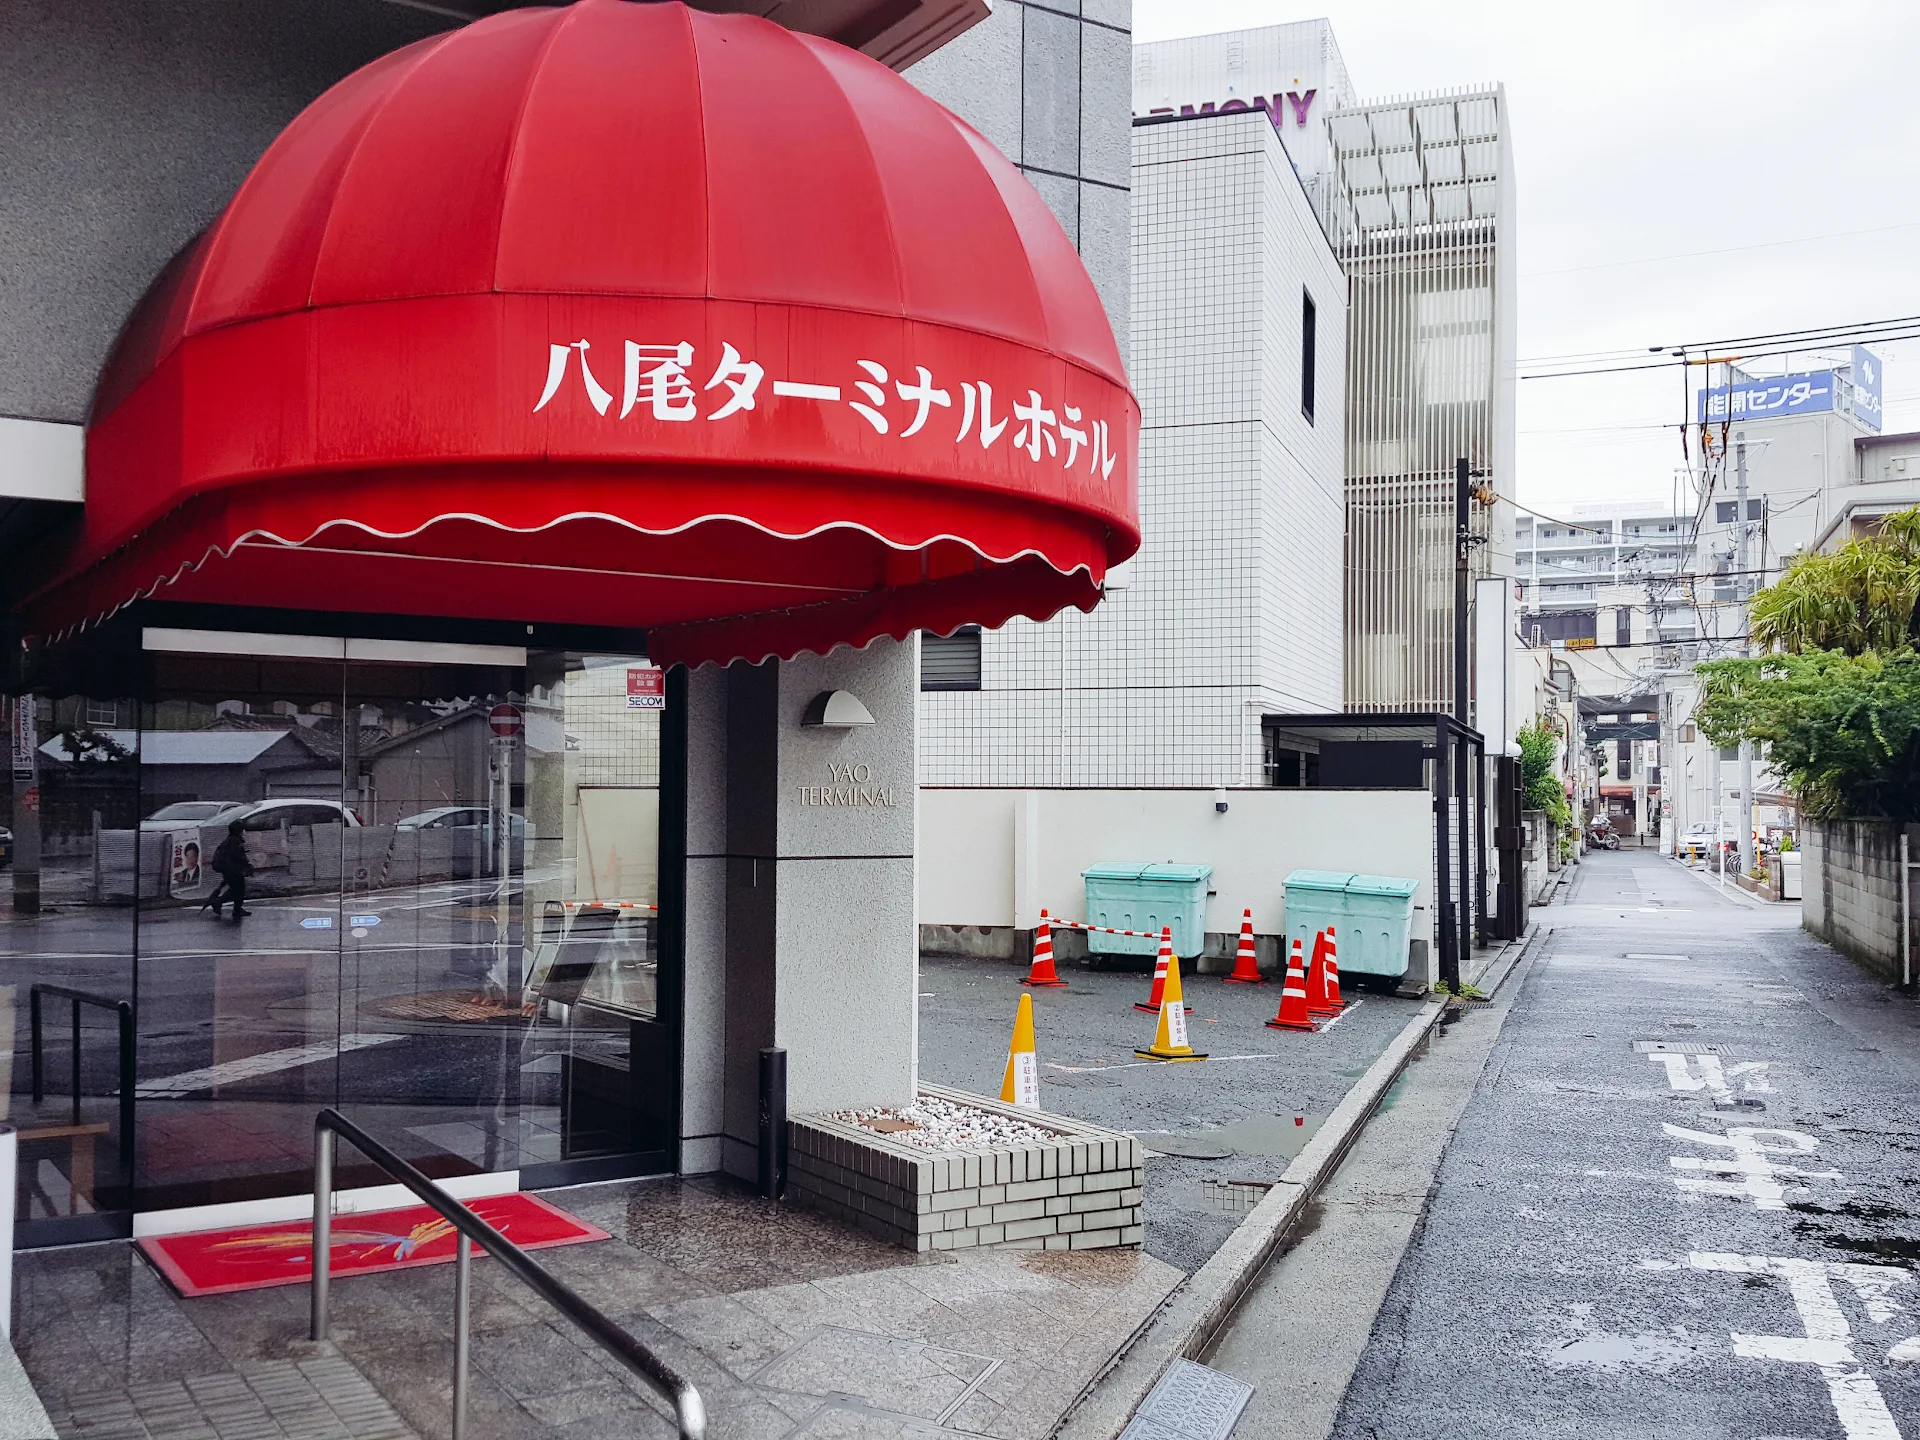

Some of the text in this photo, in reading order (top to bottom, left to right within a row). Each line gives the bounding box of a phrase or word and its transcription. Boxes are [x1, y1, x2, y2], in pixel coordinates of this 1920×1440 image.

[1703, 381, 1828, 416] 能開センター
[532, 338, 1117, 480] 八尾ターミナルホテル
[628, 696, 663, 707] SECOM
[828, 763, 871, 783] YAO
[797, 786, 898, 806] TERMINAL
